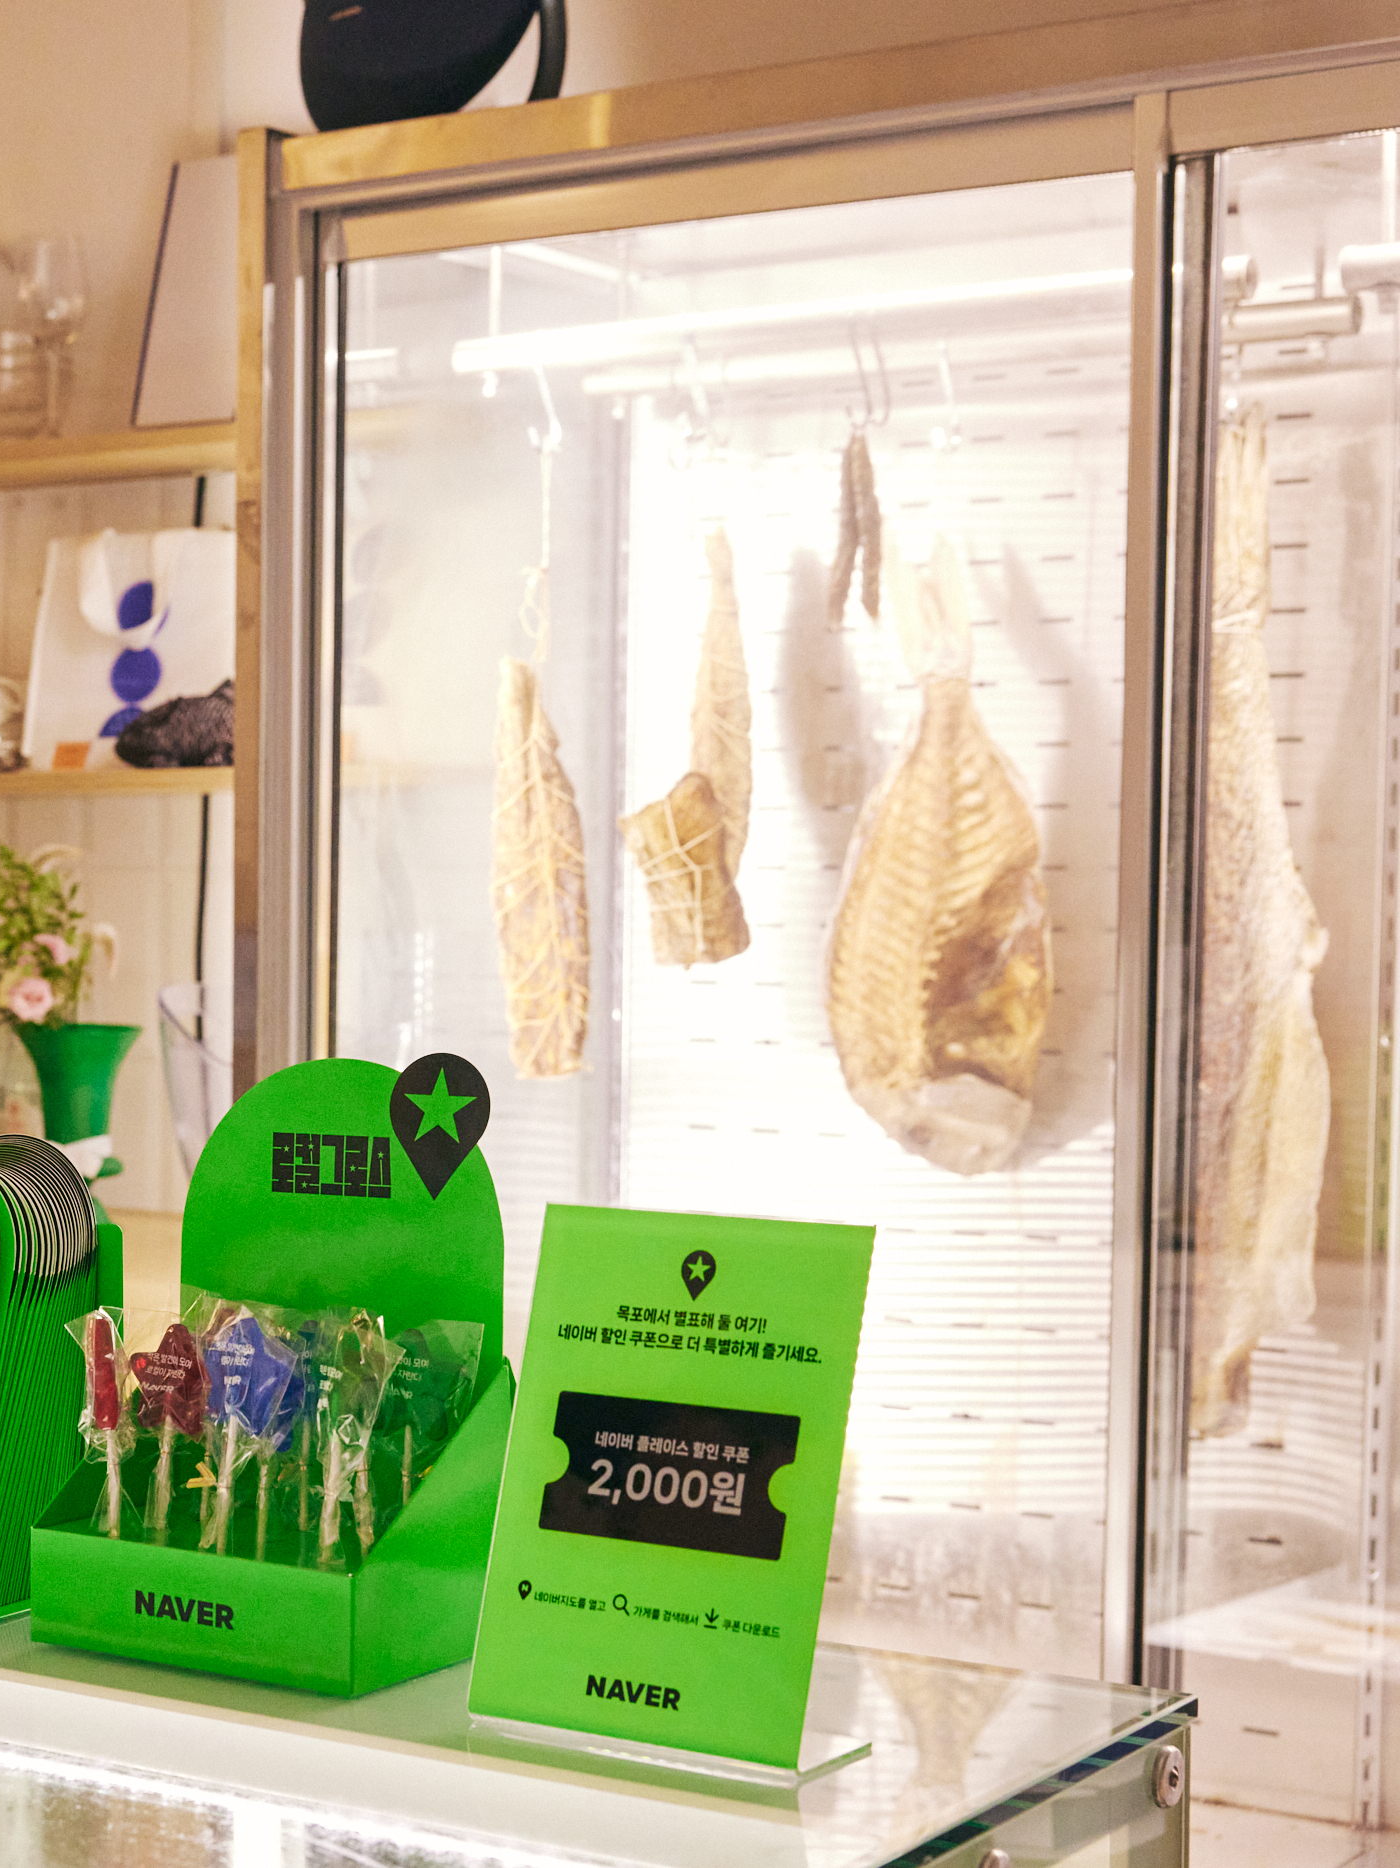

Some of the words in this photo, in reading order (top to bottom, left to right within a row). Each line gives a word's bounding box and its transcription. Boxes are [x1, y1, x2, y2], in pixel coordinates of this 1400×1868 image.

[616, 1304, 671, 1326] 목포에서
[674, 1309, 714, 1330] 별표해
[717, 1313, 732, 1332] 둘
[734, 1315, 768, 1334] 여기!
[557, 1323, 598, 1343] 네이버
[600, 1326, 628, 1346] 할인
[628, 1330, 684, 1351] 쿠폰으로
[686, 1335, 701, 1353] 더
[703, 1336, 760, 1359] 특별하게
[762, 1342, 823, 1364] 즐기세요.
[594, 1430, 635, 1451] 네이버
[636, 1435, 689, 1457] 플레이스
[692, 1441, 720, 1461] 할인
[721, 1445, 751, 1464] 쿠폰
[587, 1458, 746, 1517] 2,000원
[134, 1589, 235, 1631] NAVER
[533, 1591, 587, 1609] 네이버지도를
[632, 1605, 661, 1621] 가게를
[662, 1609, 700, 1626] 검색해서
[722, 1618, 742, 1633] 쿠폰
[742, 1622, 781, 1639] 다운로드
[585, 1674, 681, 1711] NAVER
